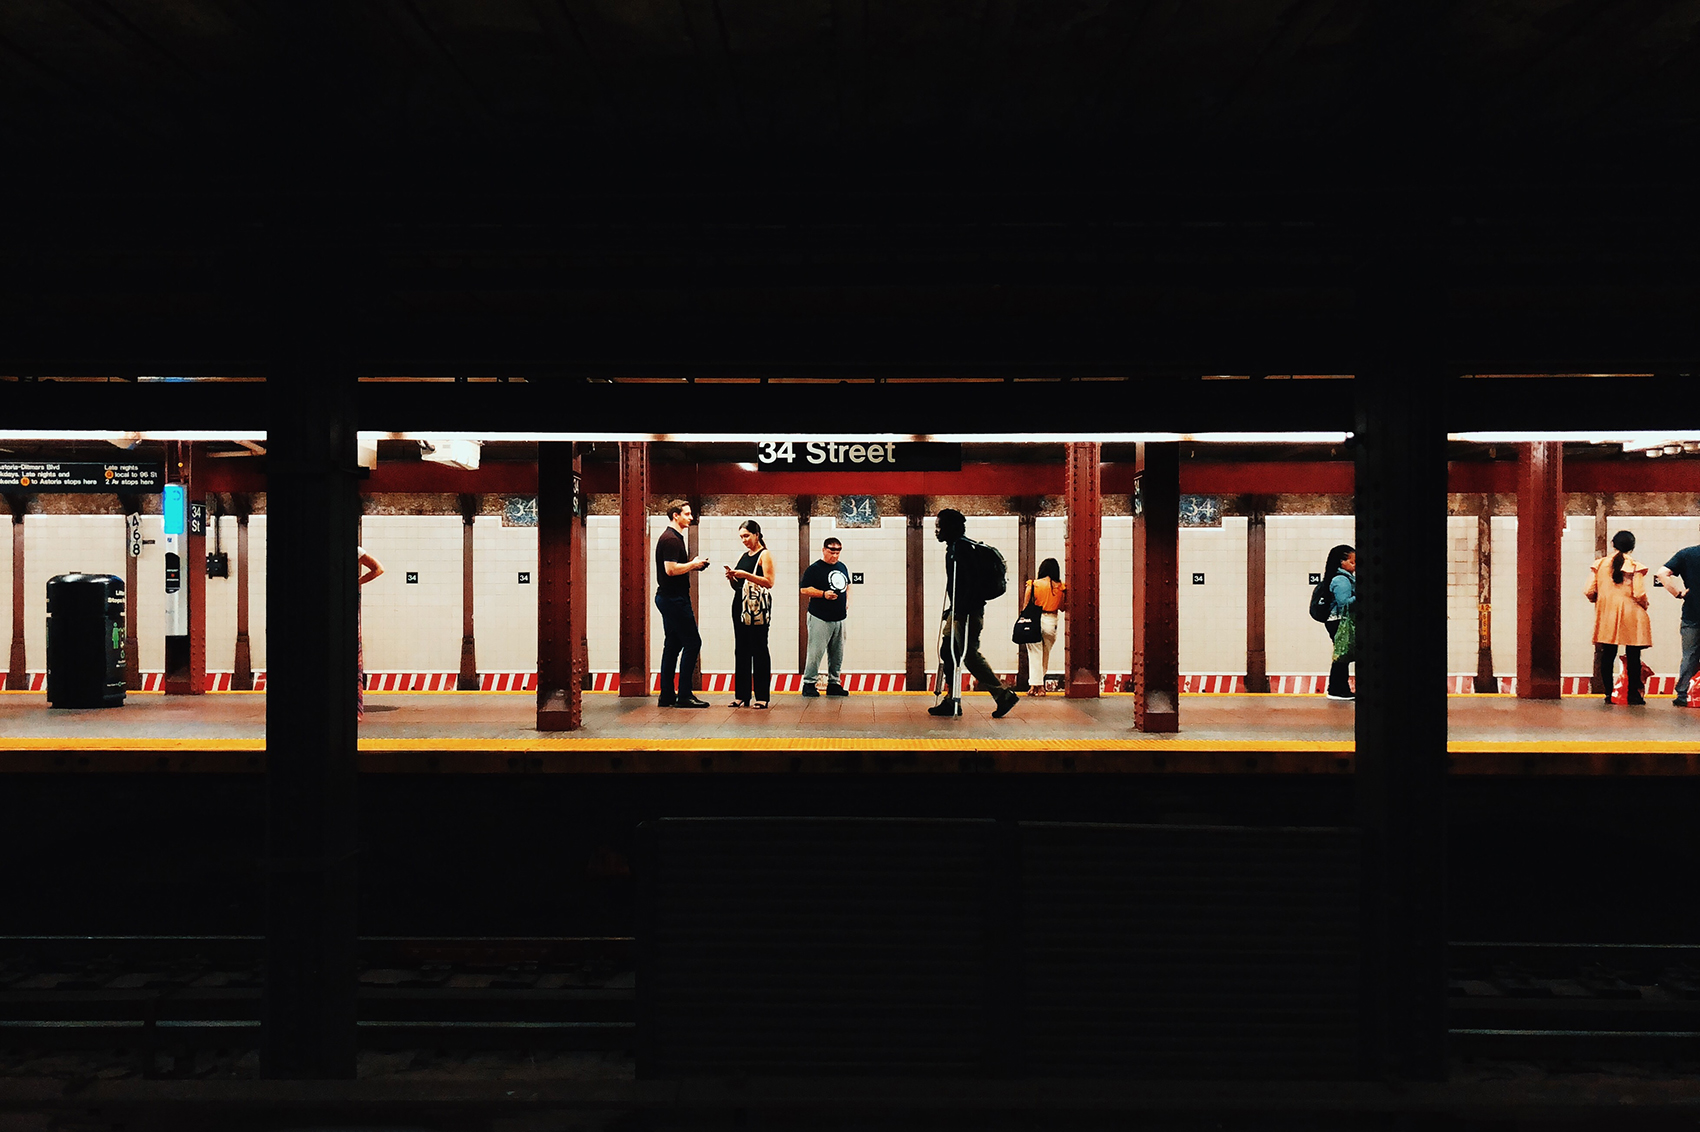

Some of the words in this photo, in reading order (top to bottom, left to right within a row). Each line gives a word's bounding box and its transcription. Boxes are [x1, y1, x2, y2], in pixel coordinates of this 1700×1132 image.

[758, 441, 796, 463] 34
[806, 441, 896, 464] Street
[191, 506, 201, 518] 34
[507, 498, 538, 517] 34
[843, 499, 871, 517] 34
[132, 515, 139, 526] 4
[191, 520, 201, 532] St
[133, 529, 140, 540] 6
[133, 544, 140, 556] 8
